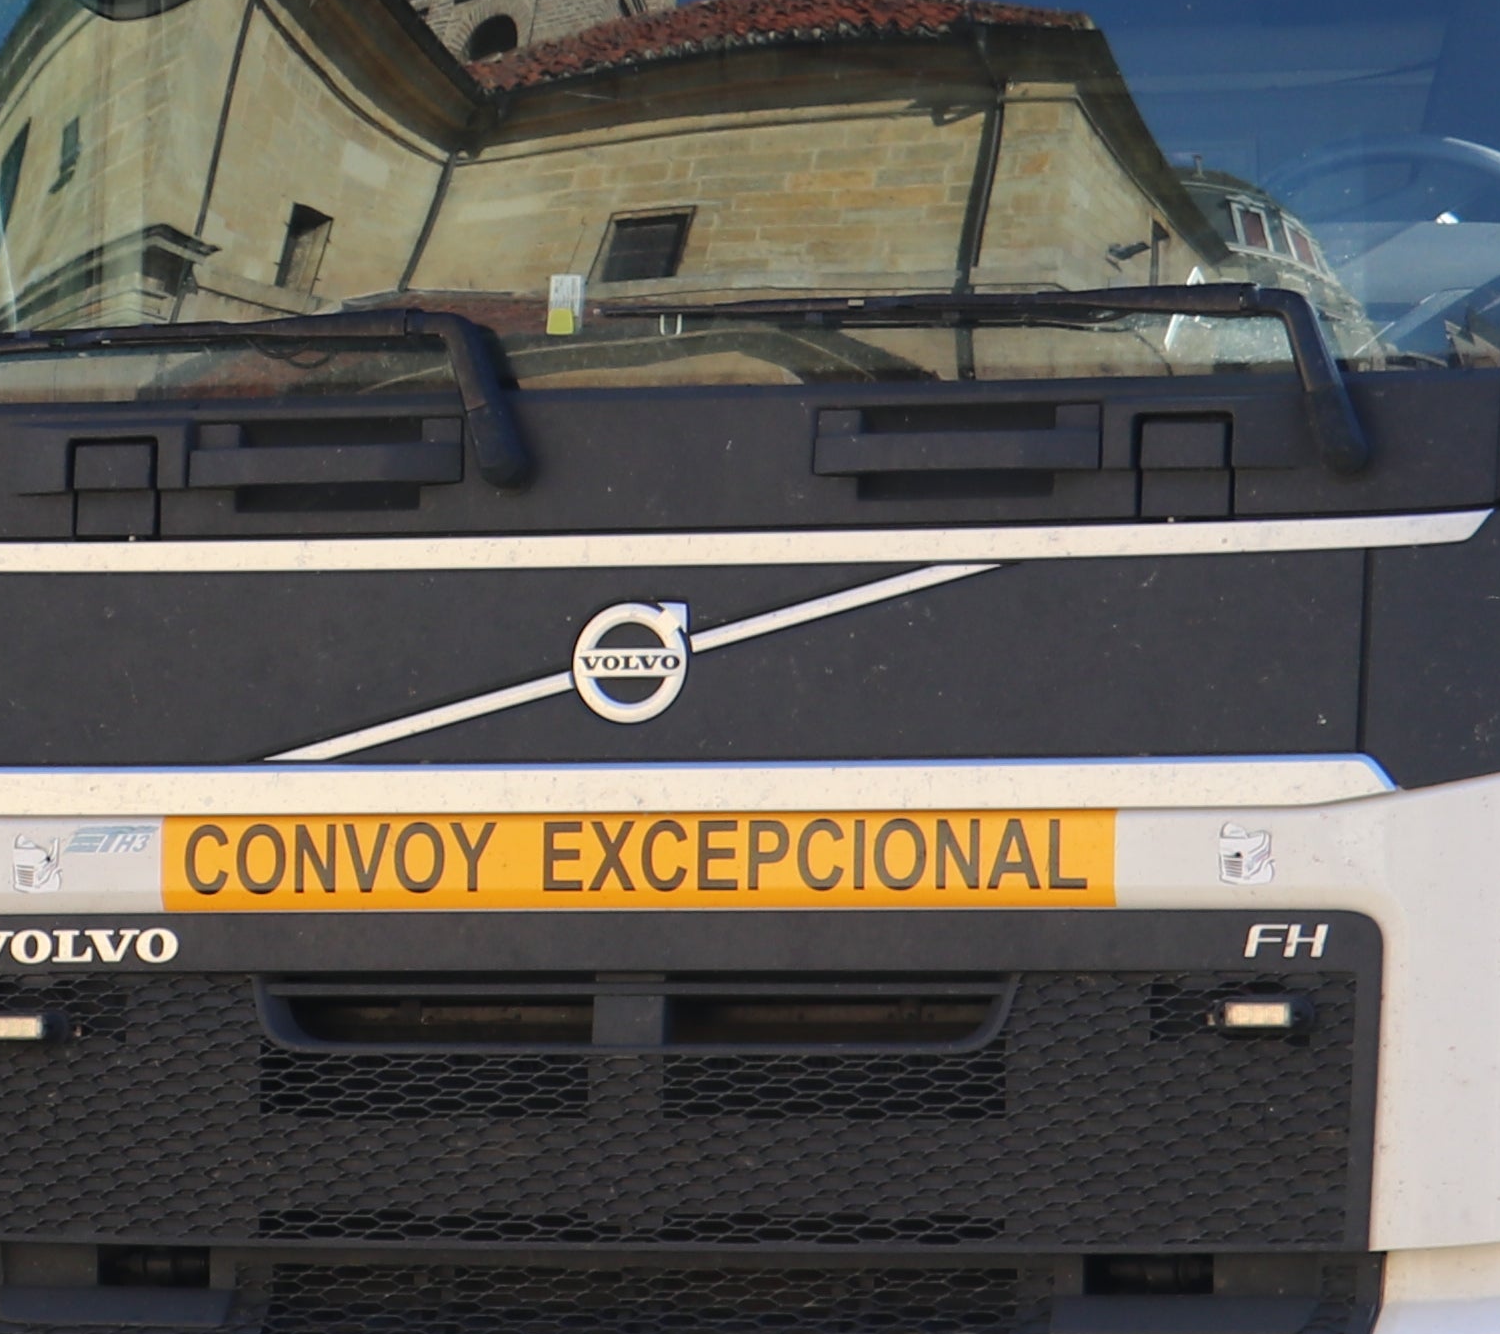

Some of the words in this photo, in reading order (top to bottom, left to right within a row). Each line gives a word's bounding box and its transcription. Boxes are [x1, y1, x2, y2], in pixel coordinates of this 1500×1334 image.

[579, 654, 681, 671] VOLVO
[184, 821, 497, 896] CONVOY
[541, 817, 1089, 893] EXCEPCIONAL
[1243, 923, 1329, 958] FH
